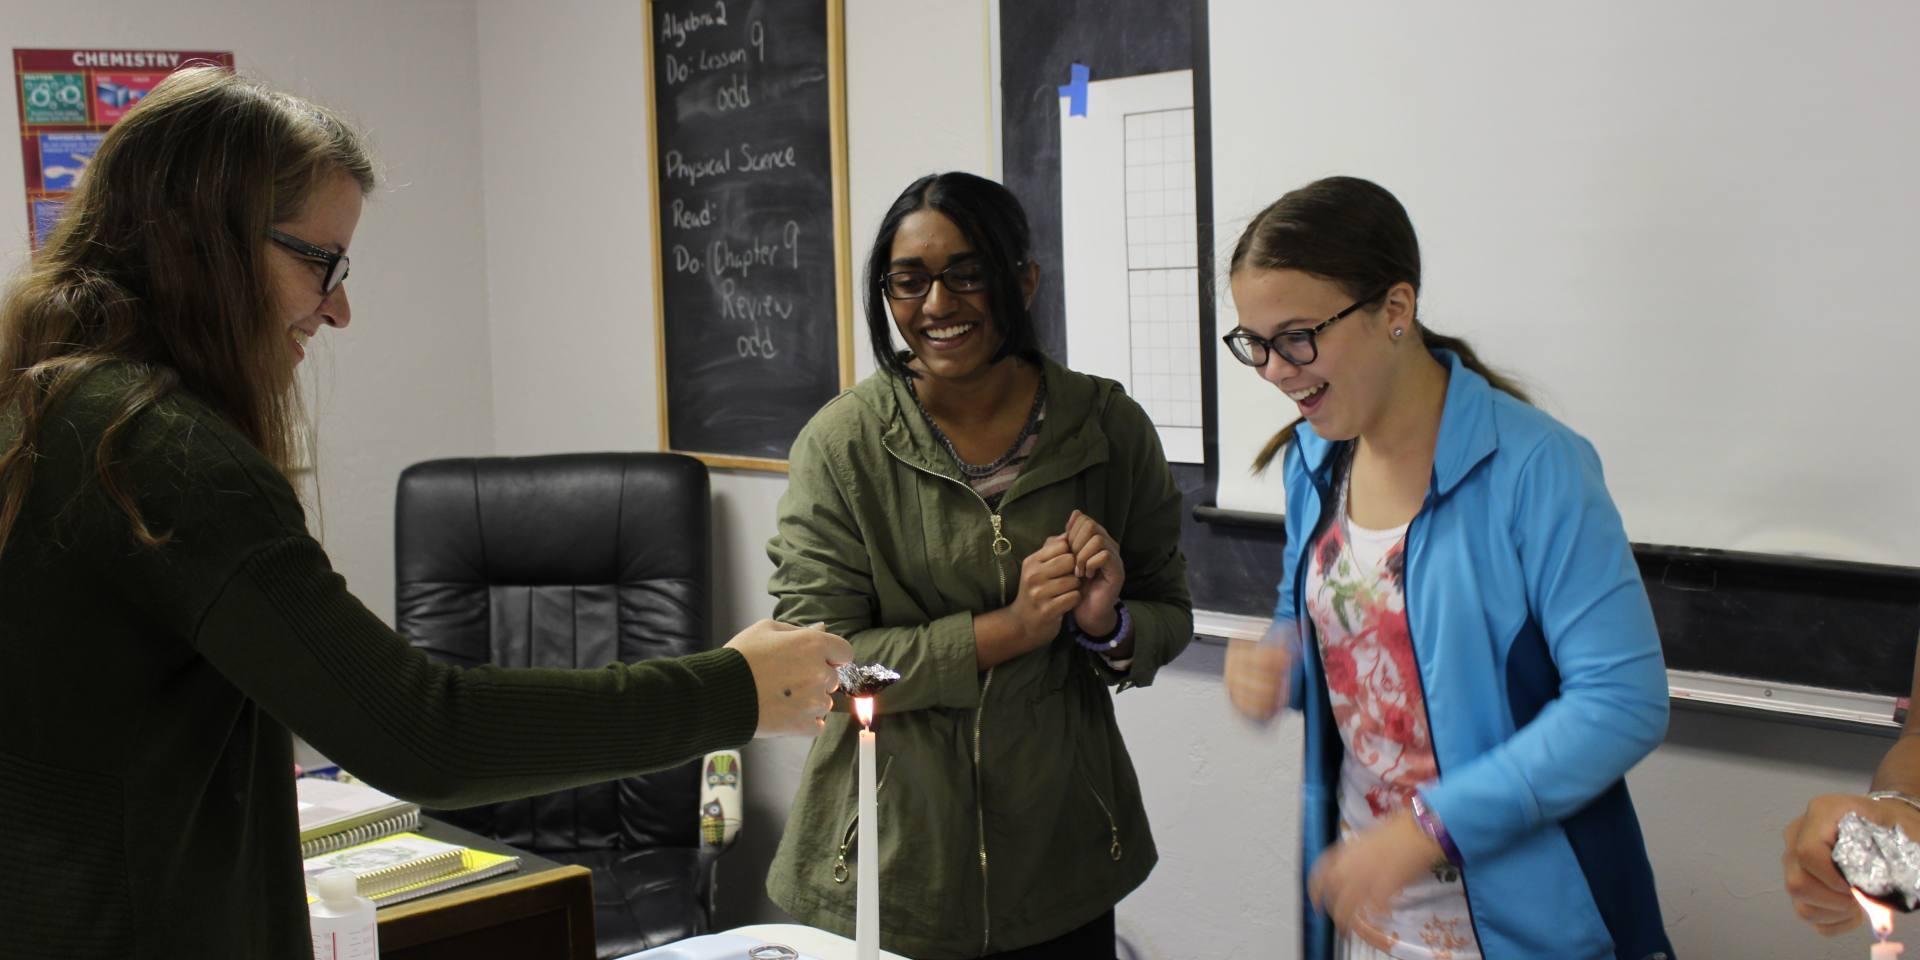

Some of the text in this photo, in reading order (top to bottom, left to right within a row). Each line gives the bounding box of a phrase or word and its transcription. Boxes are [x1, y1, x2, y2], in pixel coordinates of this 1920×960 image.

[662, 1, 727, 47] Algebra 2
[72, 52, 180, 67] CHEMISTRY
[666, 21, 764, 84] Do: Lesson 9
[717, 74, 750, 111] odd
[666, 143, 796, 186] Physical Science
[672, 198, 717, 229] Read:
[714, 236, 778, 278] Chapter
[784, 220, 799, 270] 9
[721, 277, 793, 321] Review
[737, 319, 778, 359] odd
